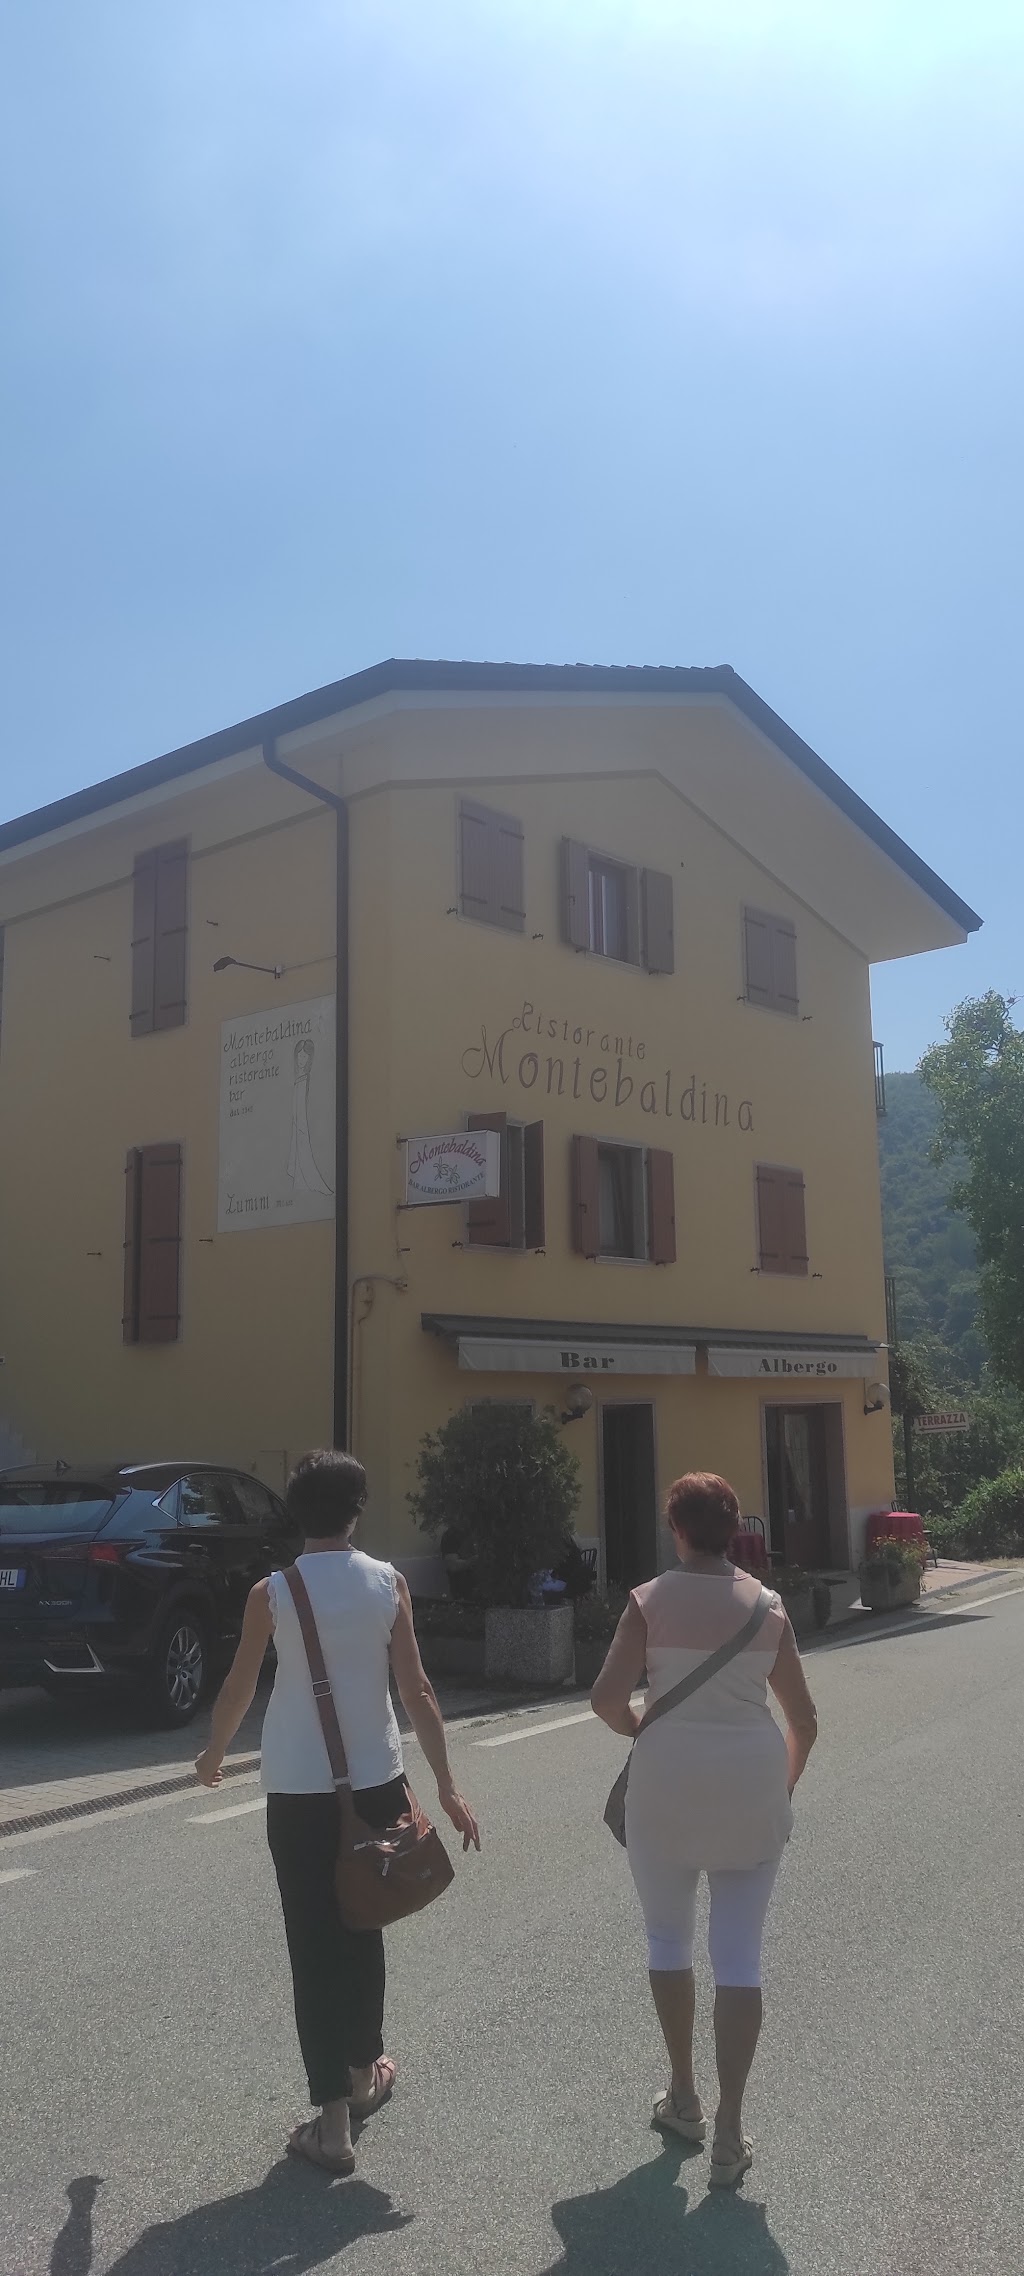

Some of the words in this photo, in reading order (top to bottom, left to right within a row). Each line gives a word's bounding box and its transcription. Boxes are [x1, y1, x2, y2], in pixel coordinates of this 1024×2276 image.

[223, 1019, 312, 1052] Montebaldina
[512, 1001, 646, 1060] Ristorante
[230, 1049, 274, 1068] albergo
[229, 1065, 280, 1085] ristorante
[461, 1025, 754, 1132] Montebaldina
[229, 1089, 245, 1102] bar
[410, 1137, 487, 1174] Montebaldina
[408, 1178, 420, 1190] BAR
[420, 1184, 448, 1195] ALBERGO
[448, 1171, 485, 1194] RISTORANTE
[560, 1352, 615, 1369] Bar
[757, 1358, 838, 1376] Albergo
[917, 1413, 966, 1426] TERRAZZA
